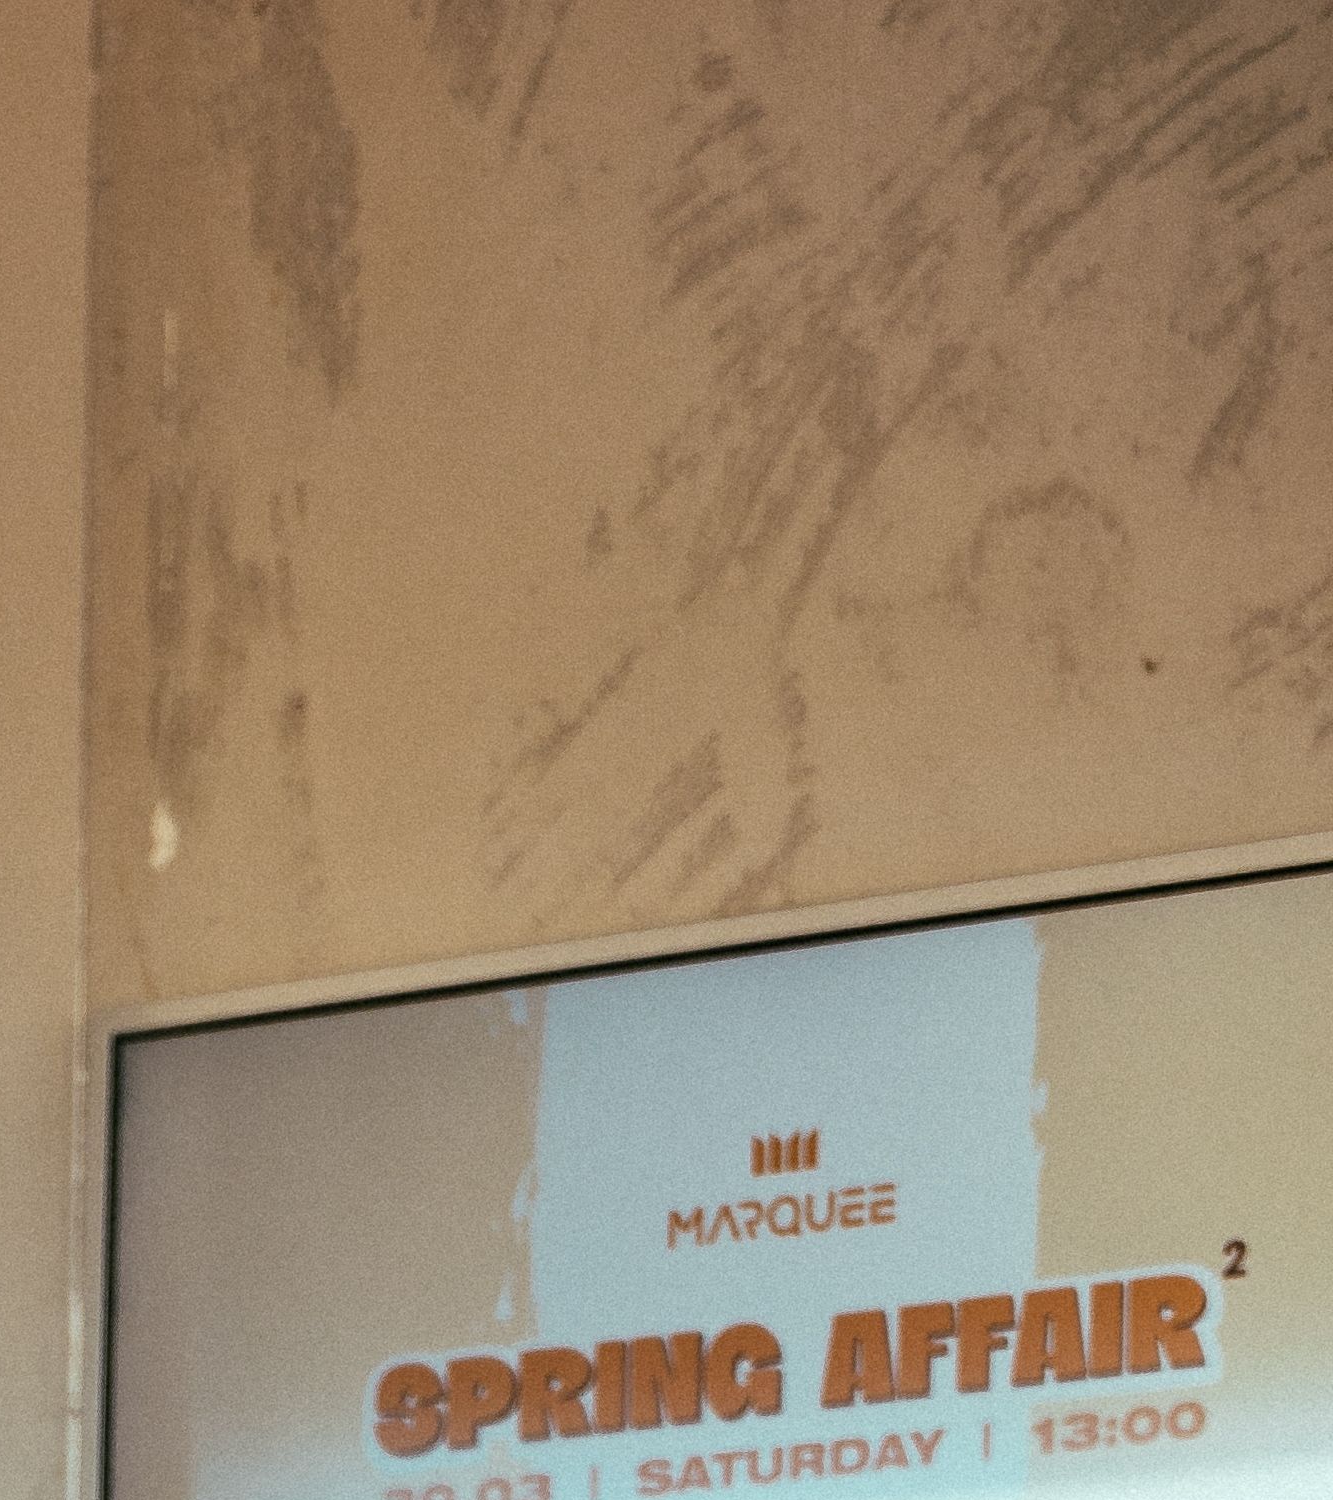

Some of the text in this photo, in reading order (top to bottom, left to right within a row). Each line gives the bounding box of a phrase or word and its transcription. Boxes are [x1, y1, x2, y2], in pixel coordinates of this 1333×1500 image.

[666, 1182, 897, 1251] MARQUEE
[372, 1238, 1249, 1459] SPRING AFFAIR 2
[636, 1428, 946, 1497] SATURDAY
[1032, 1400, 1208, 1456] 13:00
